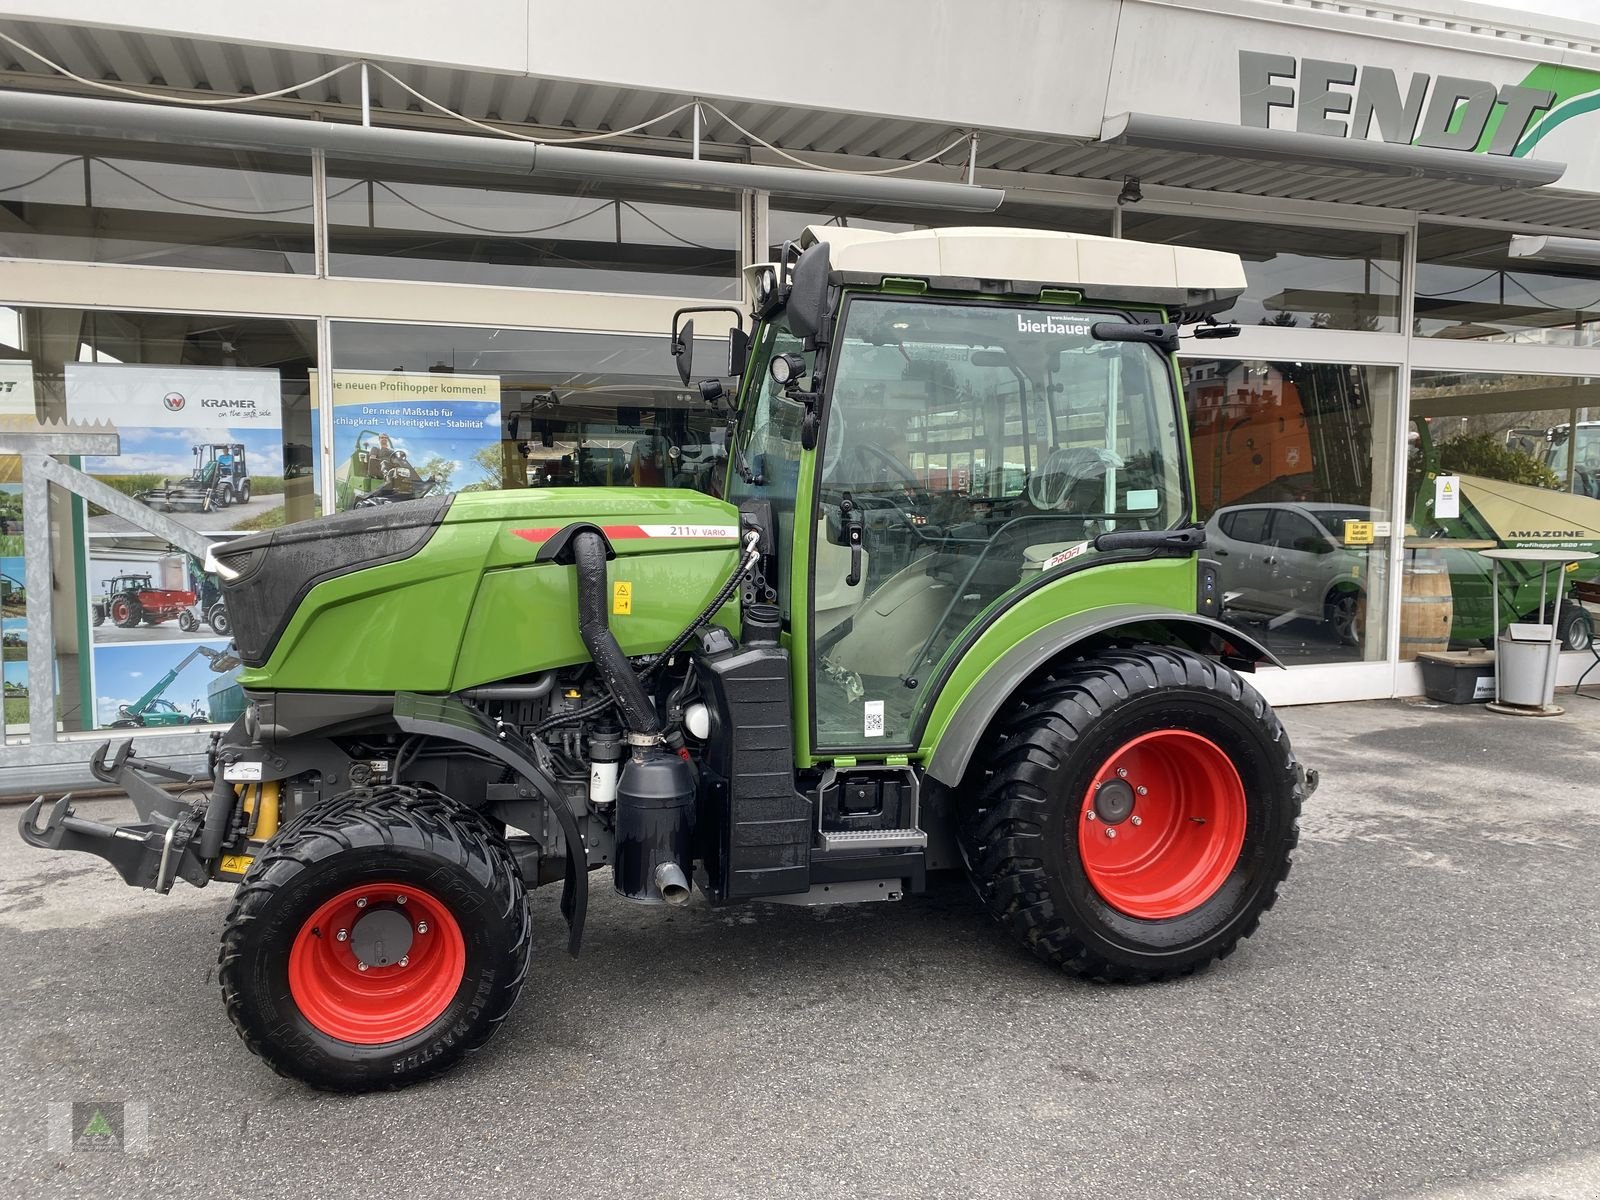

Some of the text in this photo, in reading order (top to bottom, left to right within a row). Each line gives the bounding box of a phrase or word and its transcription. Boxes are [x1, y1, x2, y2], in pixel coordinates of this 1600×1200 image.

[1238, 49, 1556, 157] FENDT
[1017, 314, 1091, 335] bierbauer
[333, 380, 487, 395] ie neuen Profihopper kommen!
[201, 399, 256, 408] KRAMER
[229, 409, 240, 417] the
[258, 409, 272, 417] side
[362, 406, 454, 417] Der neue Maßstab für
[386, 417, 440, 429] Vielseitigkeit
[446, 419, 484, 429] Stabilität
[702, 528, 727, 536] VARIO
[1508, 530, 1585, 538] AMAZONE
[1050, 546, 1081, 567] PROFI
[391, 1020, 470, 1075] MASTER
